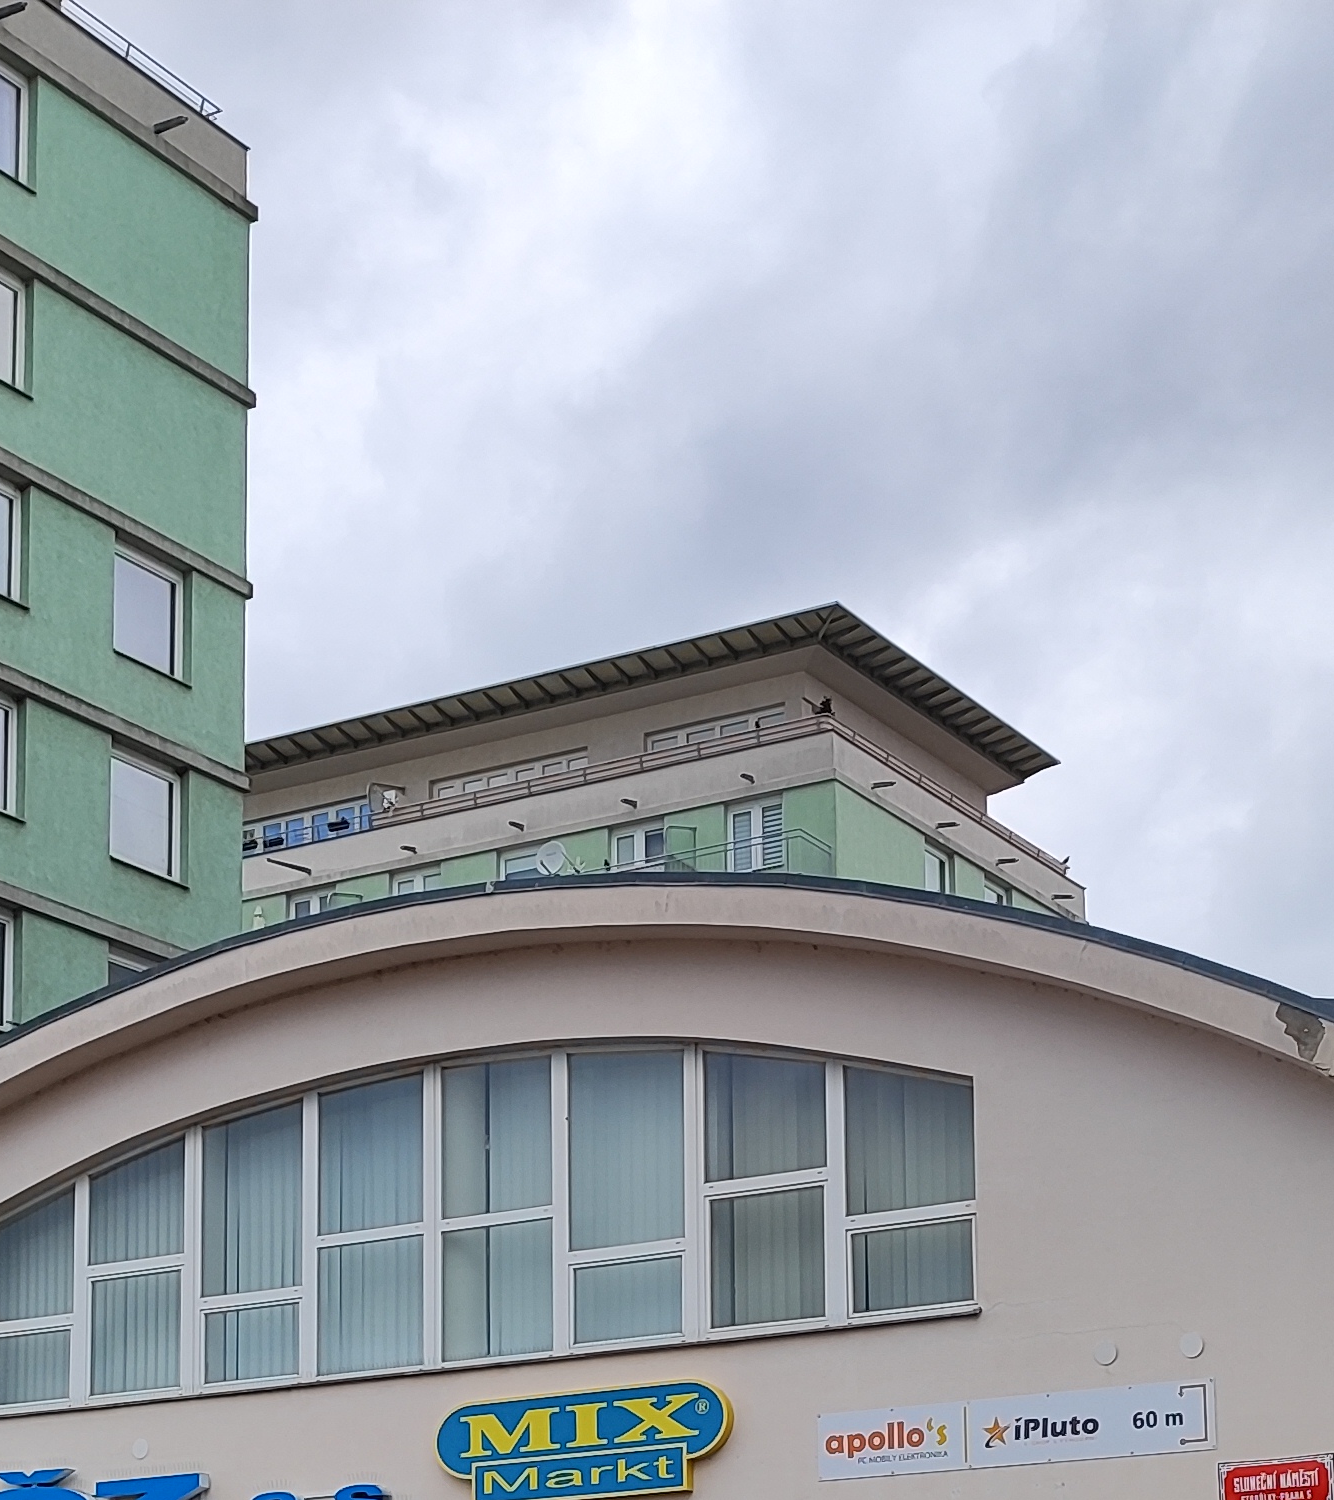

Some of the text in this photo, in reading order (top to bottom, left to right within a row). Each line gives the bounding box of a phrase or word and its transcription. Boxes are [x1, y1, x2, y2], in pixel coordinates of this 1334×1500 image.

[460, 1393, 699, 1458] MIX
[825, 1416, 948, 1458] apollo's
[1131, 1410, 1184, 1430] 60 m
[483, 1456, 675, 1494] Markt
[1233, 1467, 1320, 1493] SLUNEČNÍ NÁMĚSTÍ
